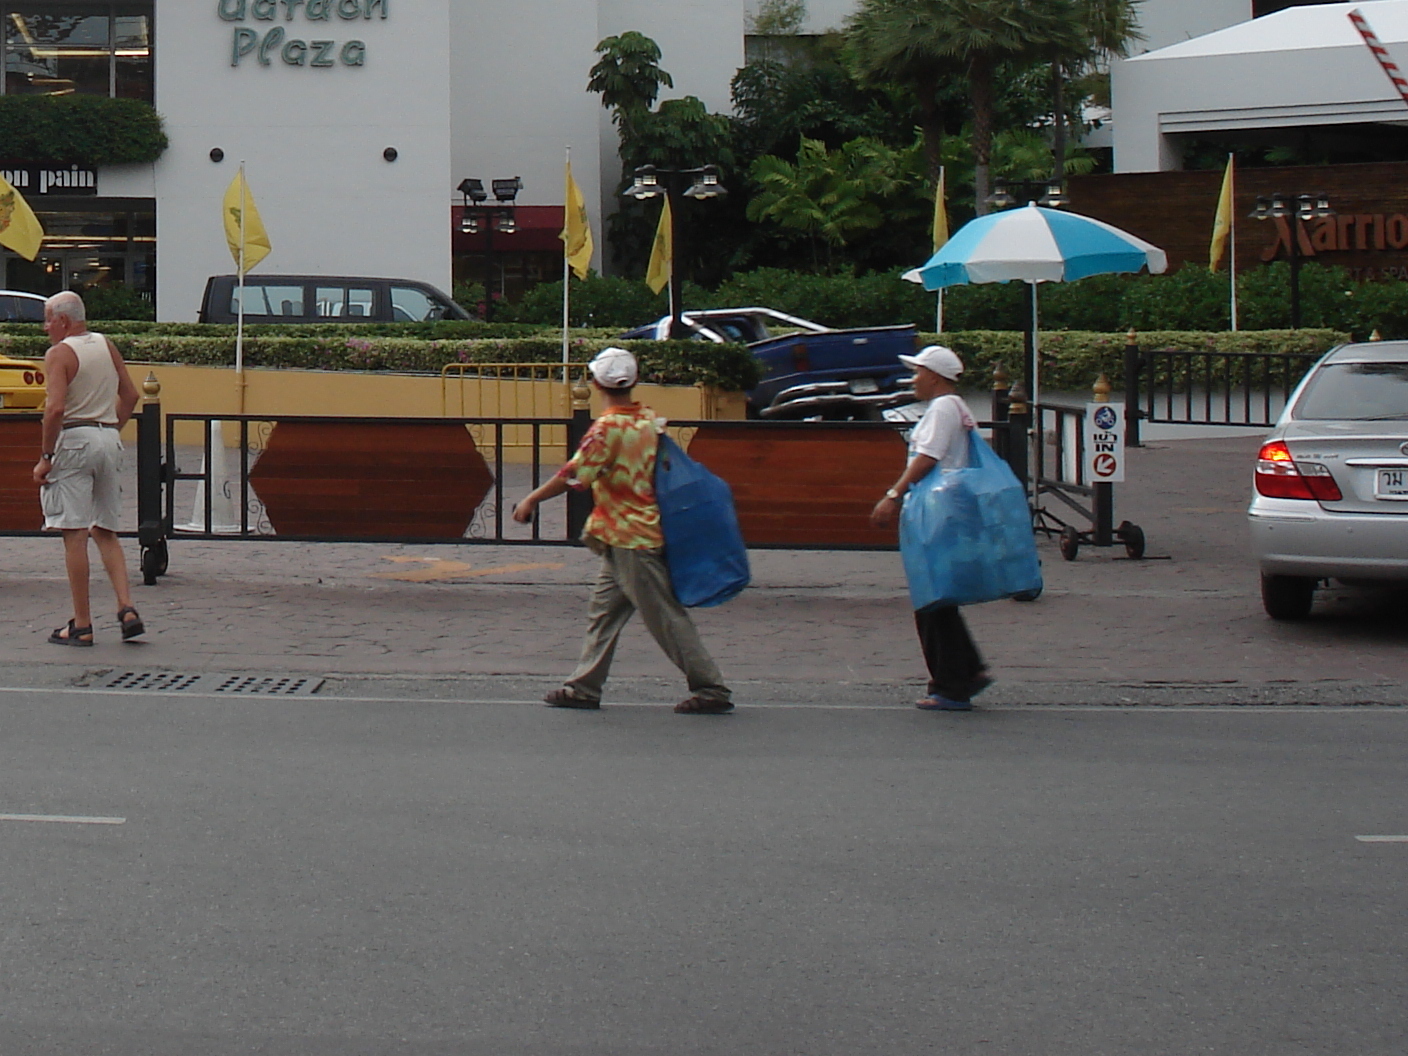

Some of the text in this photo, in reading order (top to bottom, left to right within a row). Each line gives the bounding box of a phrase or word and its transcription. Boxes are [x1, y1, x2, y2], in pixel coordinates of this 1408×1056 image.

[231, 26, 366, 67] Plaza
[39, 163, 94, 194] pain
[1093, 431, 1118, 442] เข้า
[1095, 443, 1115, 452] IN
